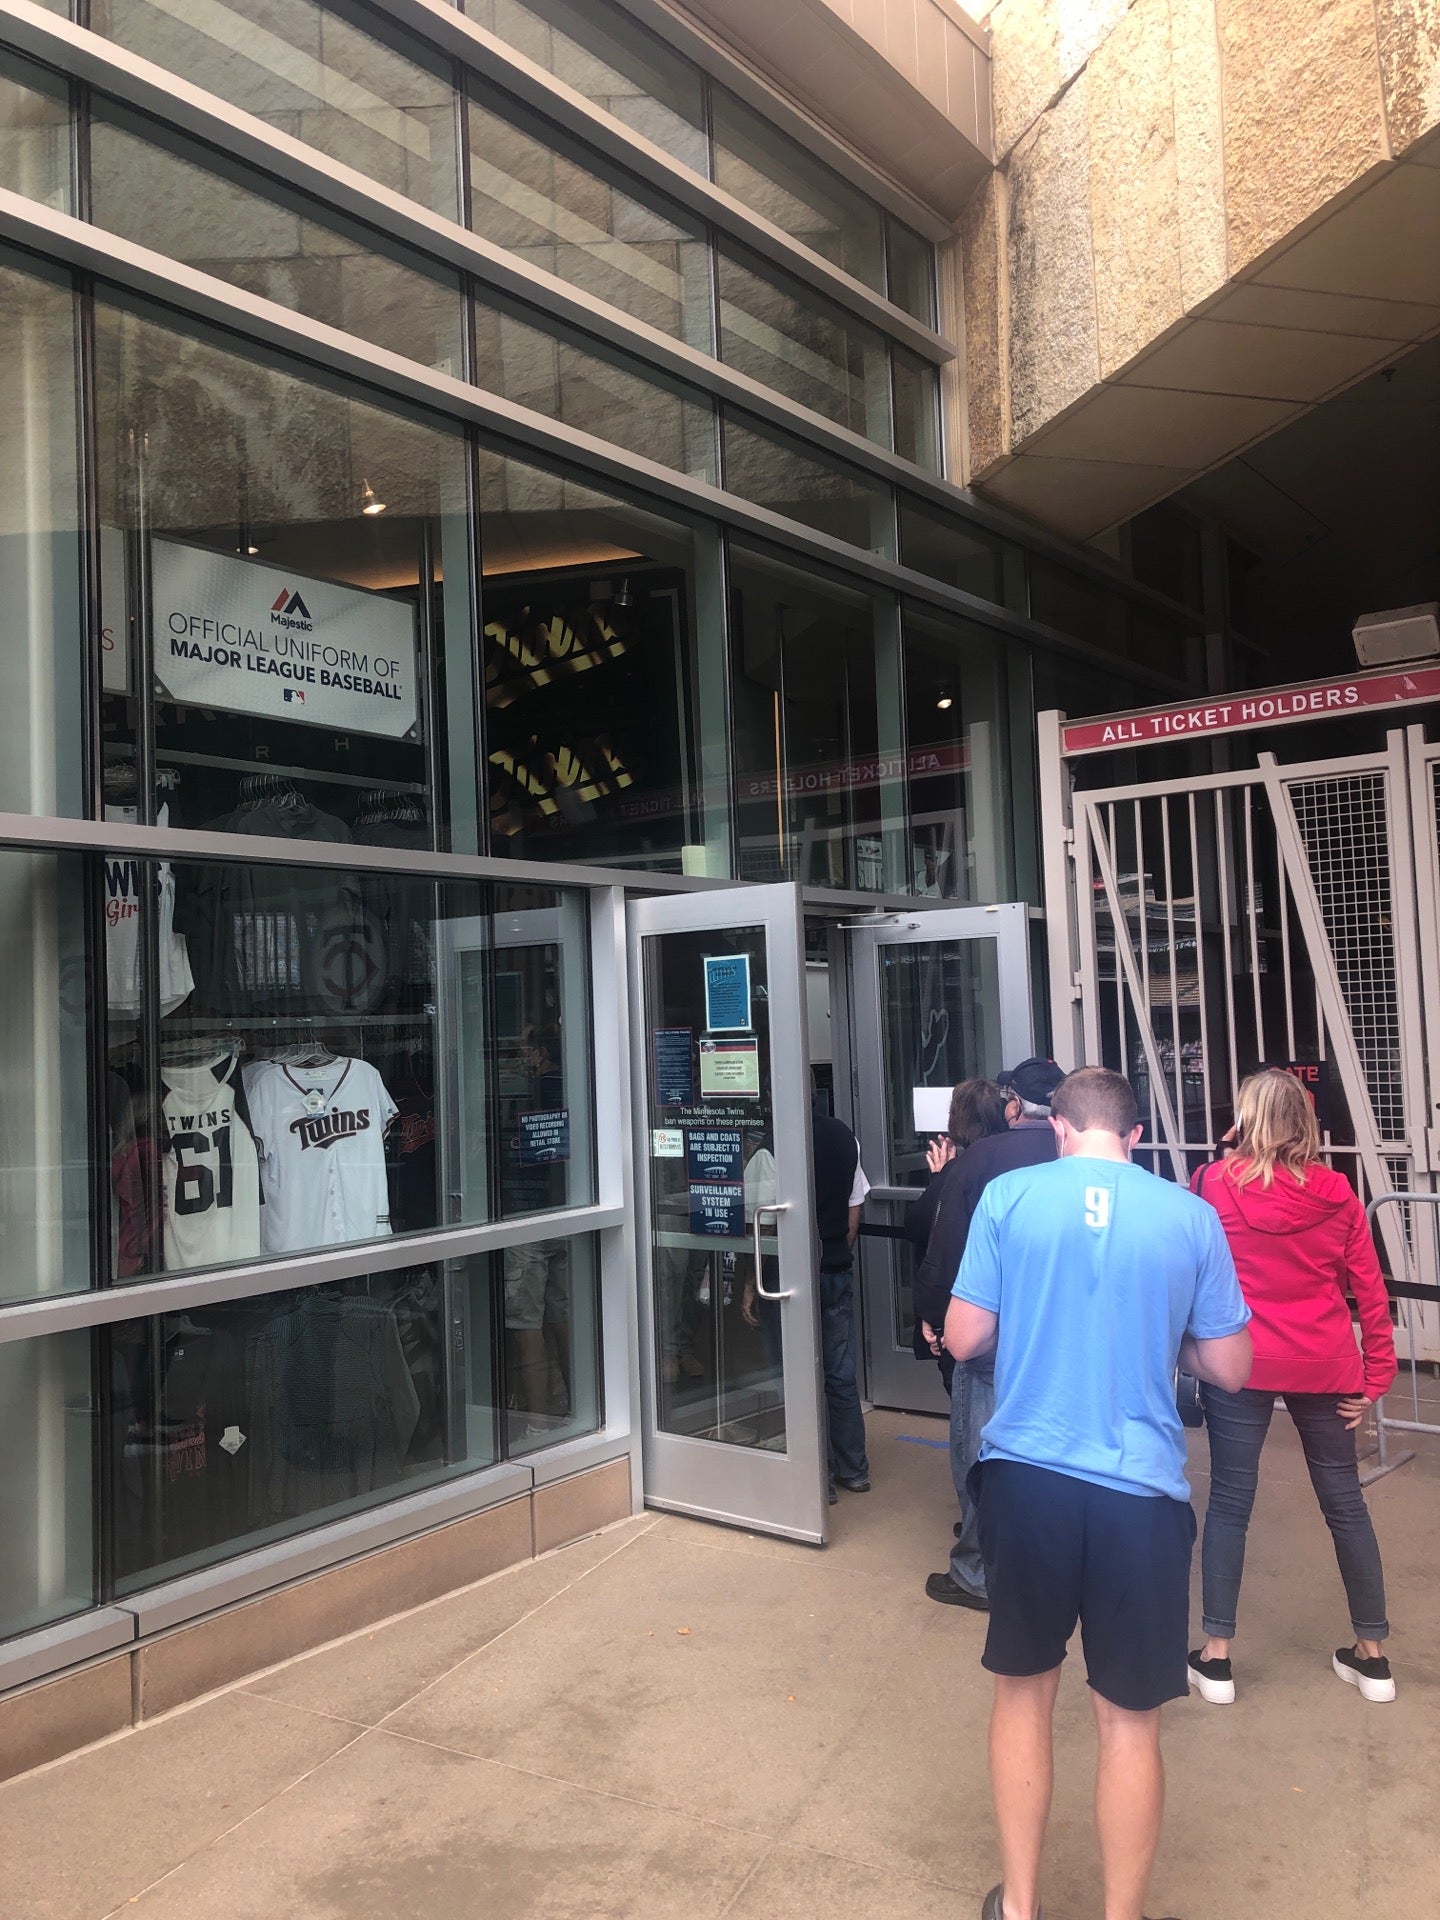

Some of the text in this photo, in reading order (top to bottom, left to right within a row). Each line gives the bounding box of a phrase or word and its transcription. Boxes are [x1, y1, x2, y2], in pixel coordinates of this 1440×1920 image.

[270, 612, 313, 632] Majestic
[168, 612, 400, 679] OFFICIAL UNIFORM OF
[170, 638, 402, 700] MAJOR LEAGUE BASEBALL
[1101, 686, 1360, 743] ALL TICKET HOLDERS
[680, 1107, 745, 1115] The Minnesota Twins
[168, 1109, 231, 1131] TWINS
[664, 1117, 677, 1126] ban
[678, 1118, 706, 1126] weapons
[715, 1117, 734, 1126] these
[734, 1118, 765, 1127] premises
[289, 1106, 371, 1151] Twins
[688, 1132, 705, 1141] BAGS
[706, 1132, 719, 1141] AND
[720, 1133, 741, 1142] COATS
[689, 1142, 702, 1152] ARE
[703, 1143, 731, 1152] SUBJECT
[731, 1143, 740, 1152] TO
[697, 1153, 733, 1163] INSPECTION
[170, 1125, 233, 1216] 61
[690, 1184, 742, 1196] SURVEILLANCE
[702, 1196, 731, 1207] SYSTEM
[1084, 1186, 1109, 1228] 9
[705, 1208, 713, 1217] IN
[714, 1208, 729, 1218] USE
